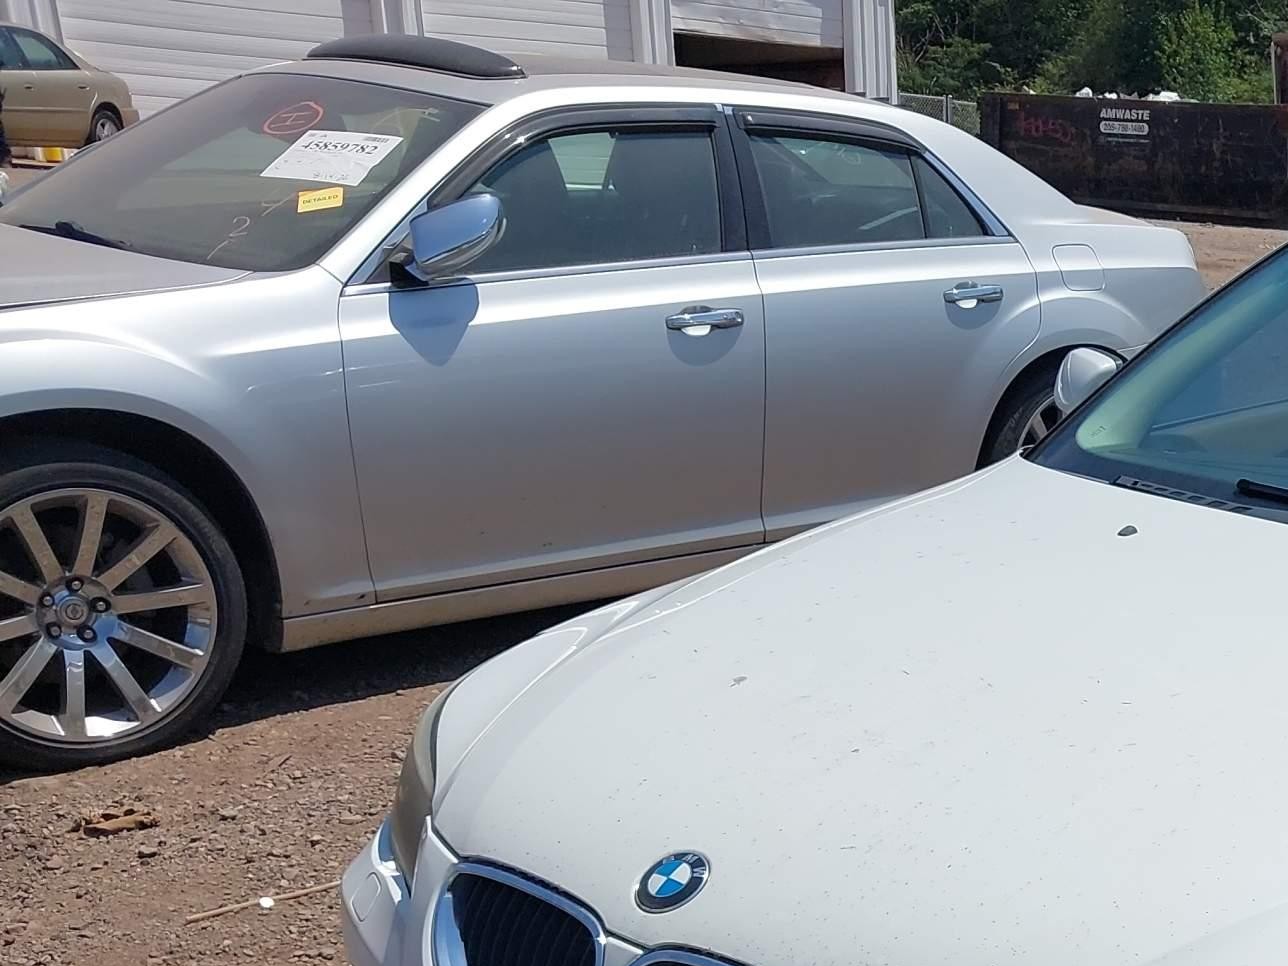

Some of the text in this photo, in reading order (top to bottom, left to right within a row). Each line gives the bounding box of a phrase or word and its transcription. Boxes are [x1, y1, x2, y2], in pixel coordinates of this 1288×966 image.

[1100, 107, 1151, 120] AMWASTE
[301, 140, 379, 155] 45859782
[302, 193, 338, 205] DETAILED
